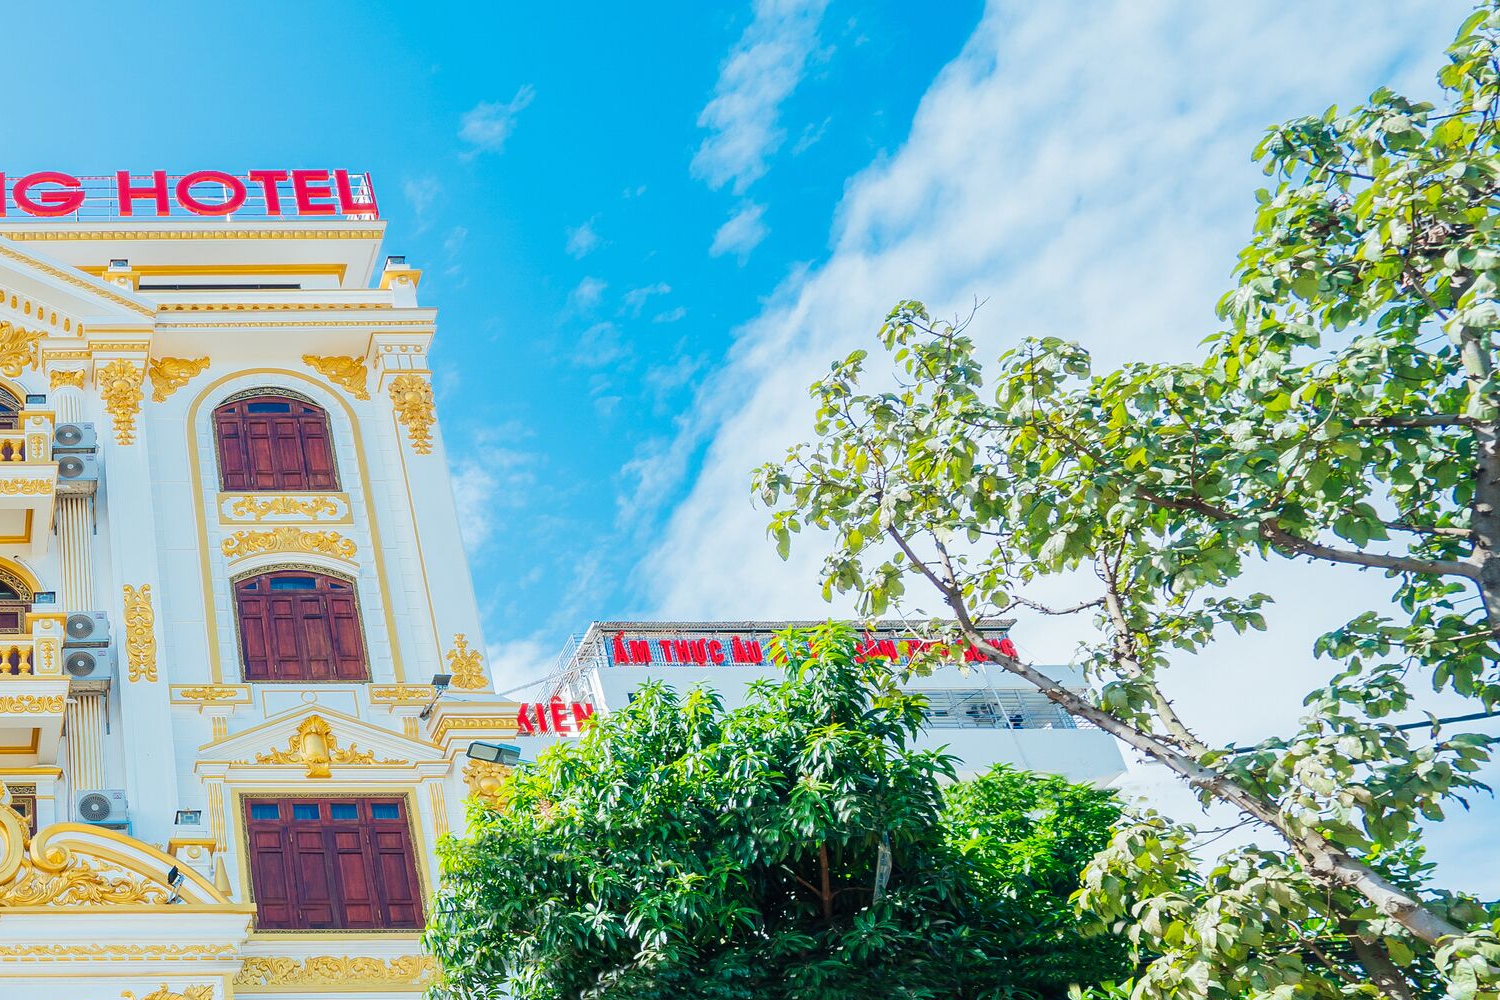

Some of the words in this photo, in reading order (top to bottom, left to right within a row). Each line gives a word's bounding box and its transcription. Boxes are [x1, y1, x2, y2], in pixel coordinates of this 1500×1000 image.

[116, 170, 378, 217] HOTEL
[659, 638, 724, 666] THỰC
[517, 695, 594, 737] KIỆN
